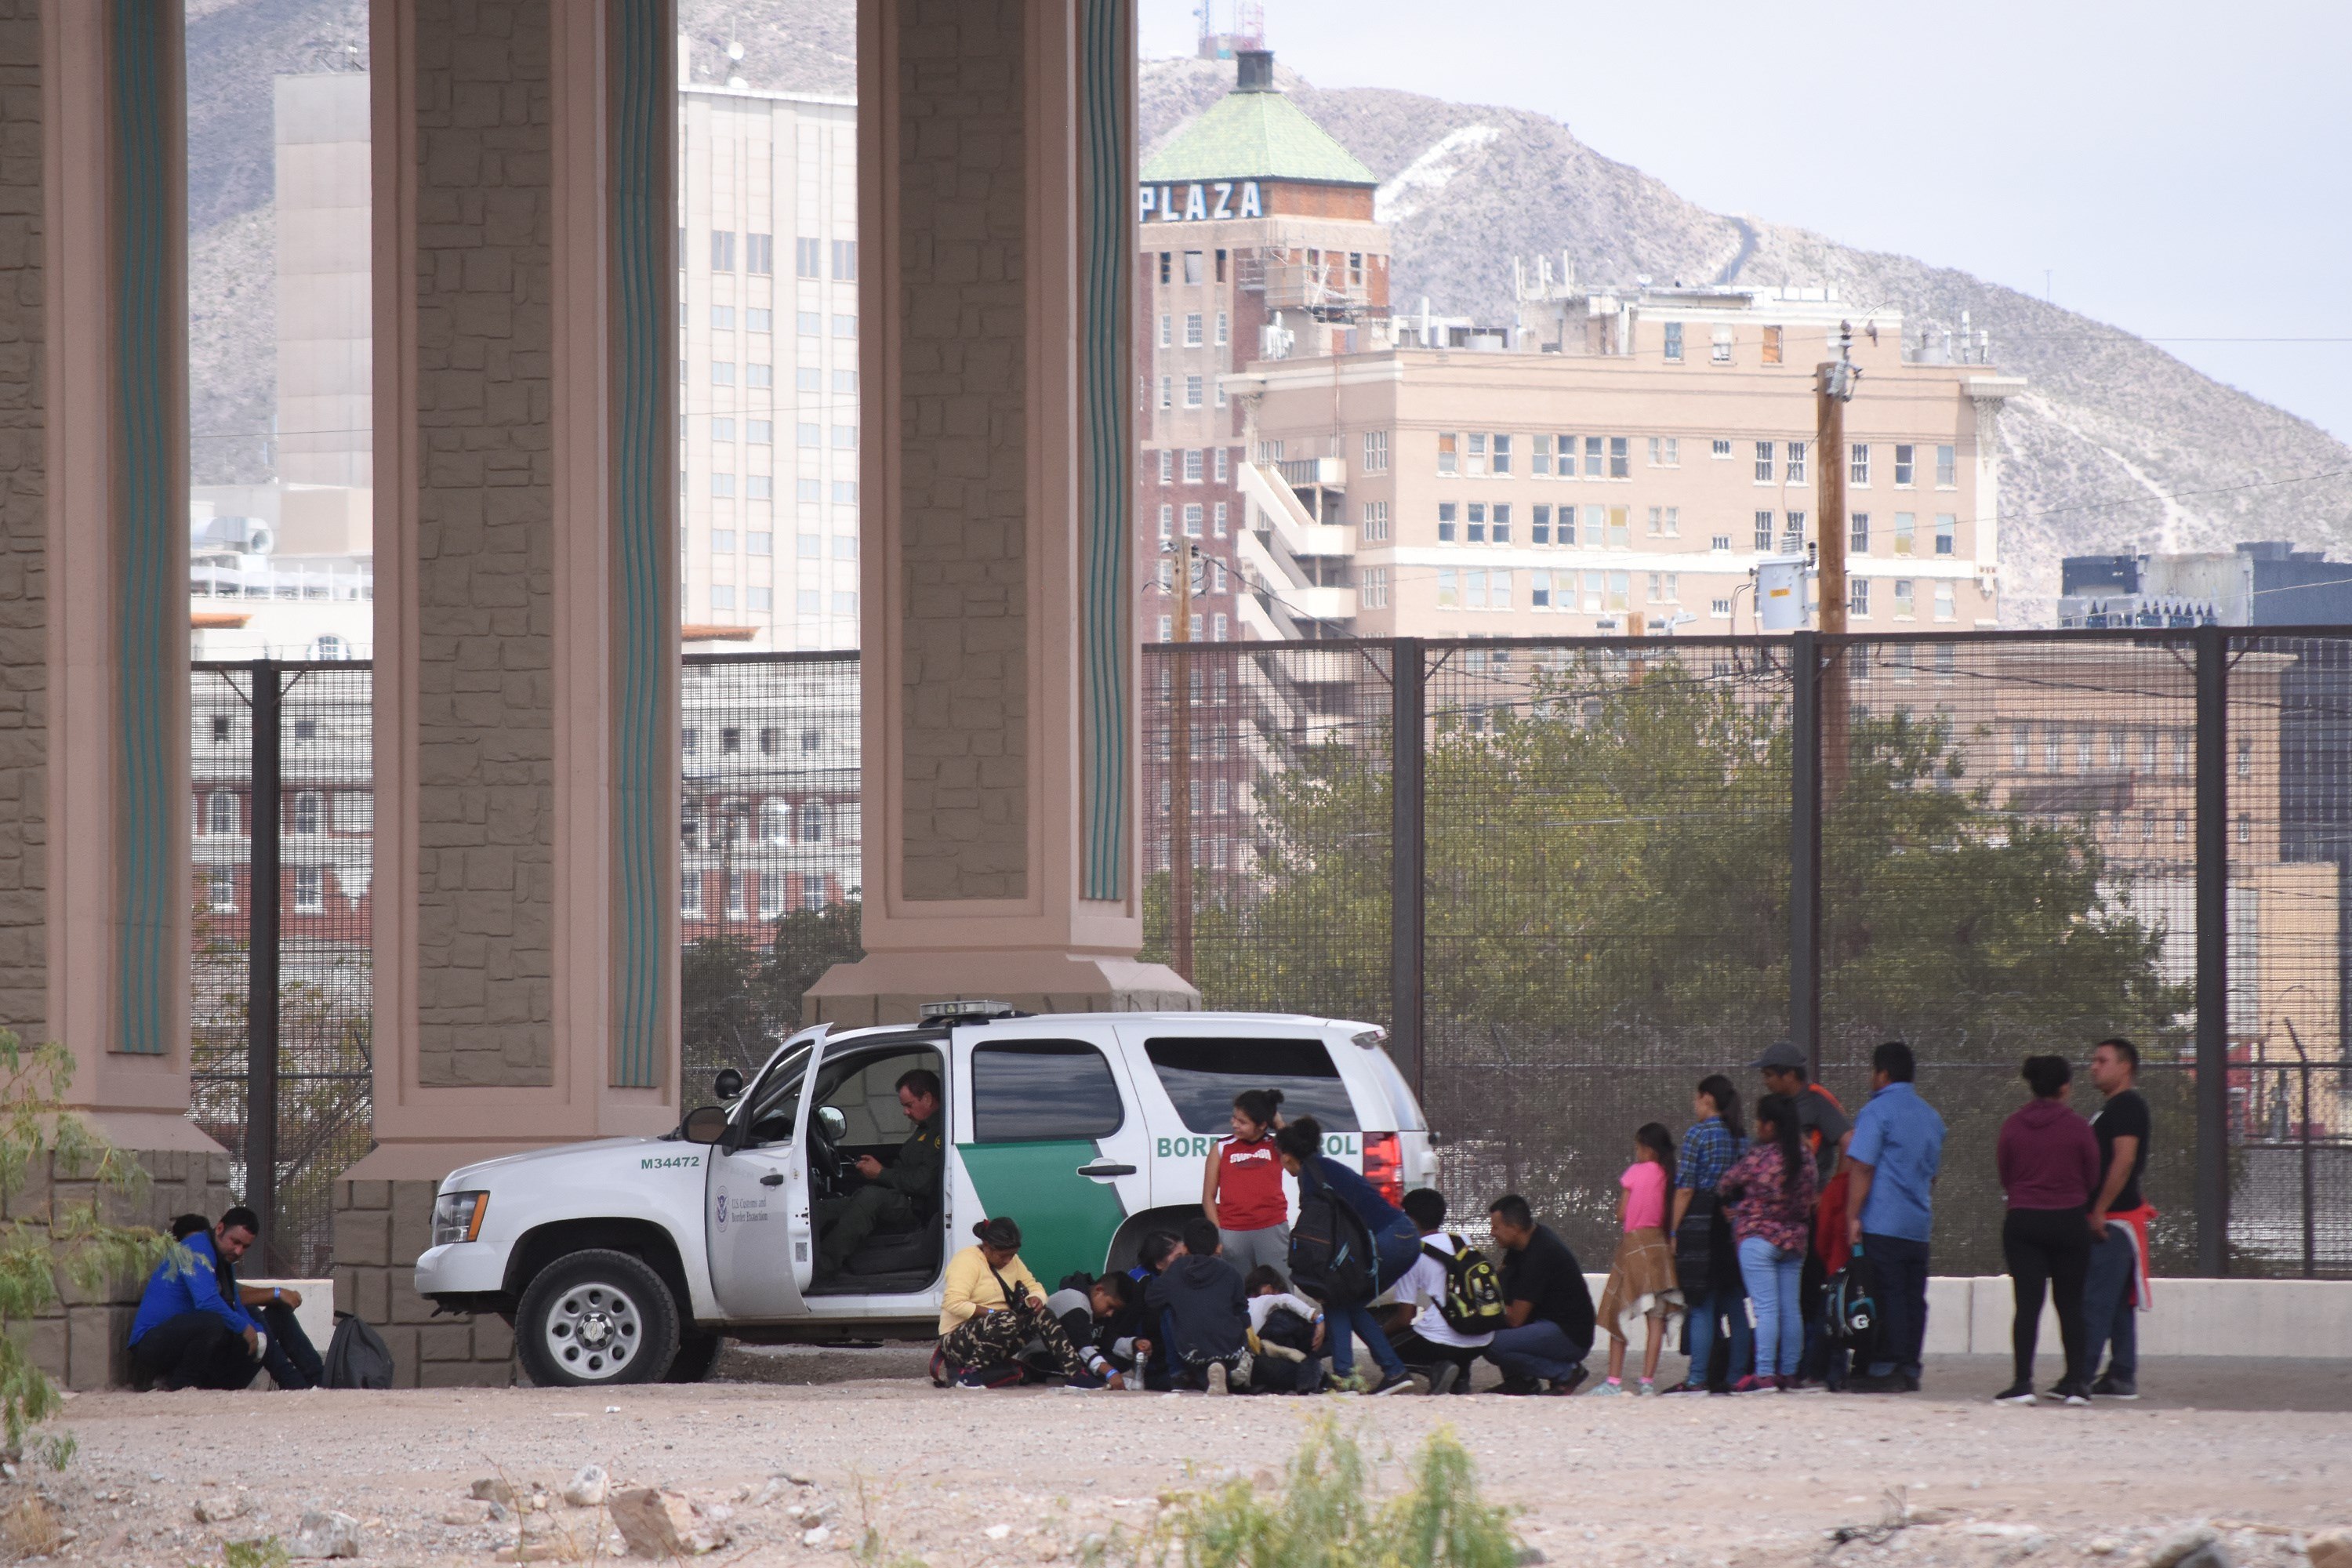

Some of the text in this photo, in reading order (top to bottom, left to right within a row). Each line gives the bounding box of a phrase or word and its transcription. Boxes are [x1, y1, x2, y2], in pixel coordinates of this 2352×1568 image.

[1138, 181, 1263, 223] PLAZA
[1320, 1134, 1358, 1156] OL
[641, 1156, 699, 1170] M34472
[740, 1198, 758, 1208] Customs
[758, 1196, 767, 1207] and
[731, 1210, 768, 1222] Border Protection
